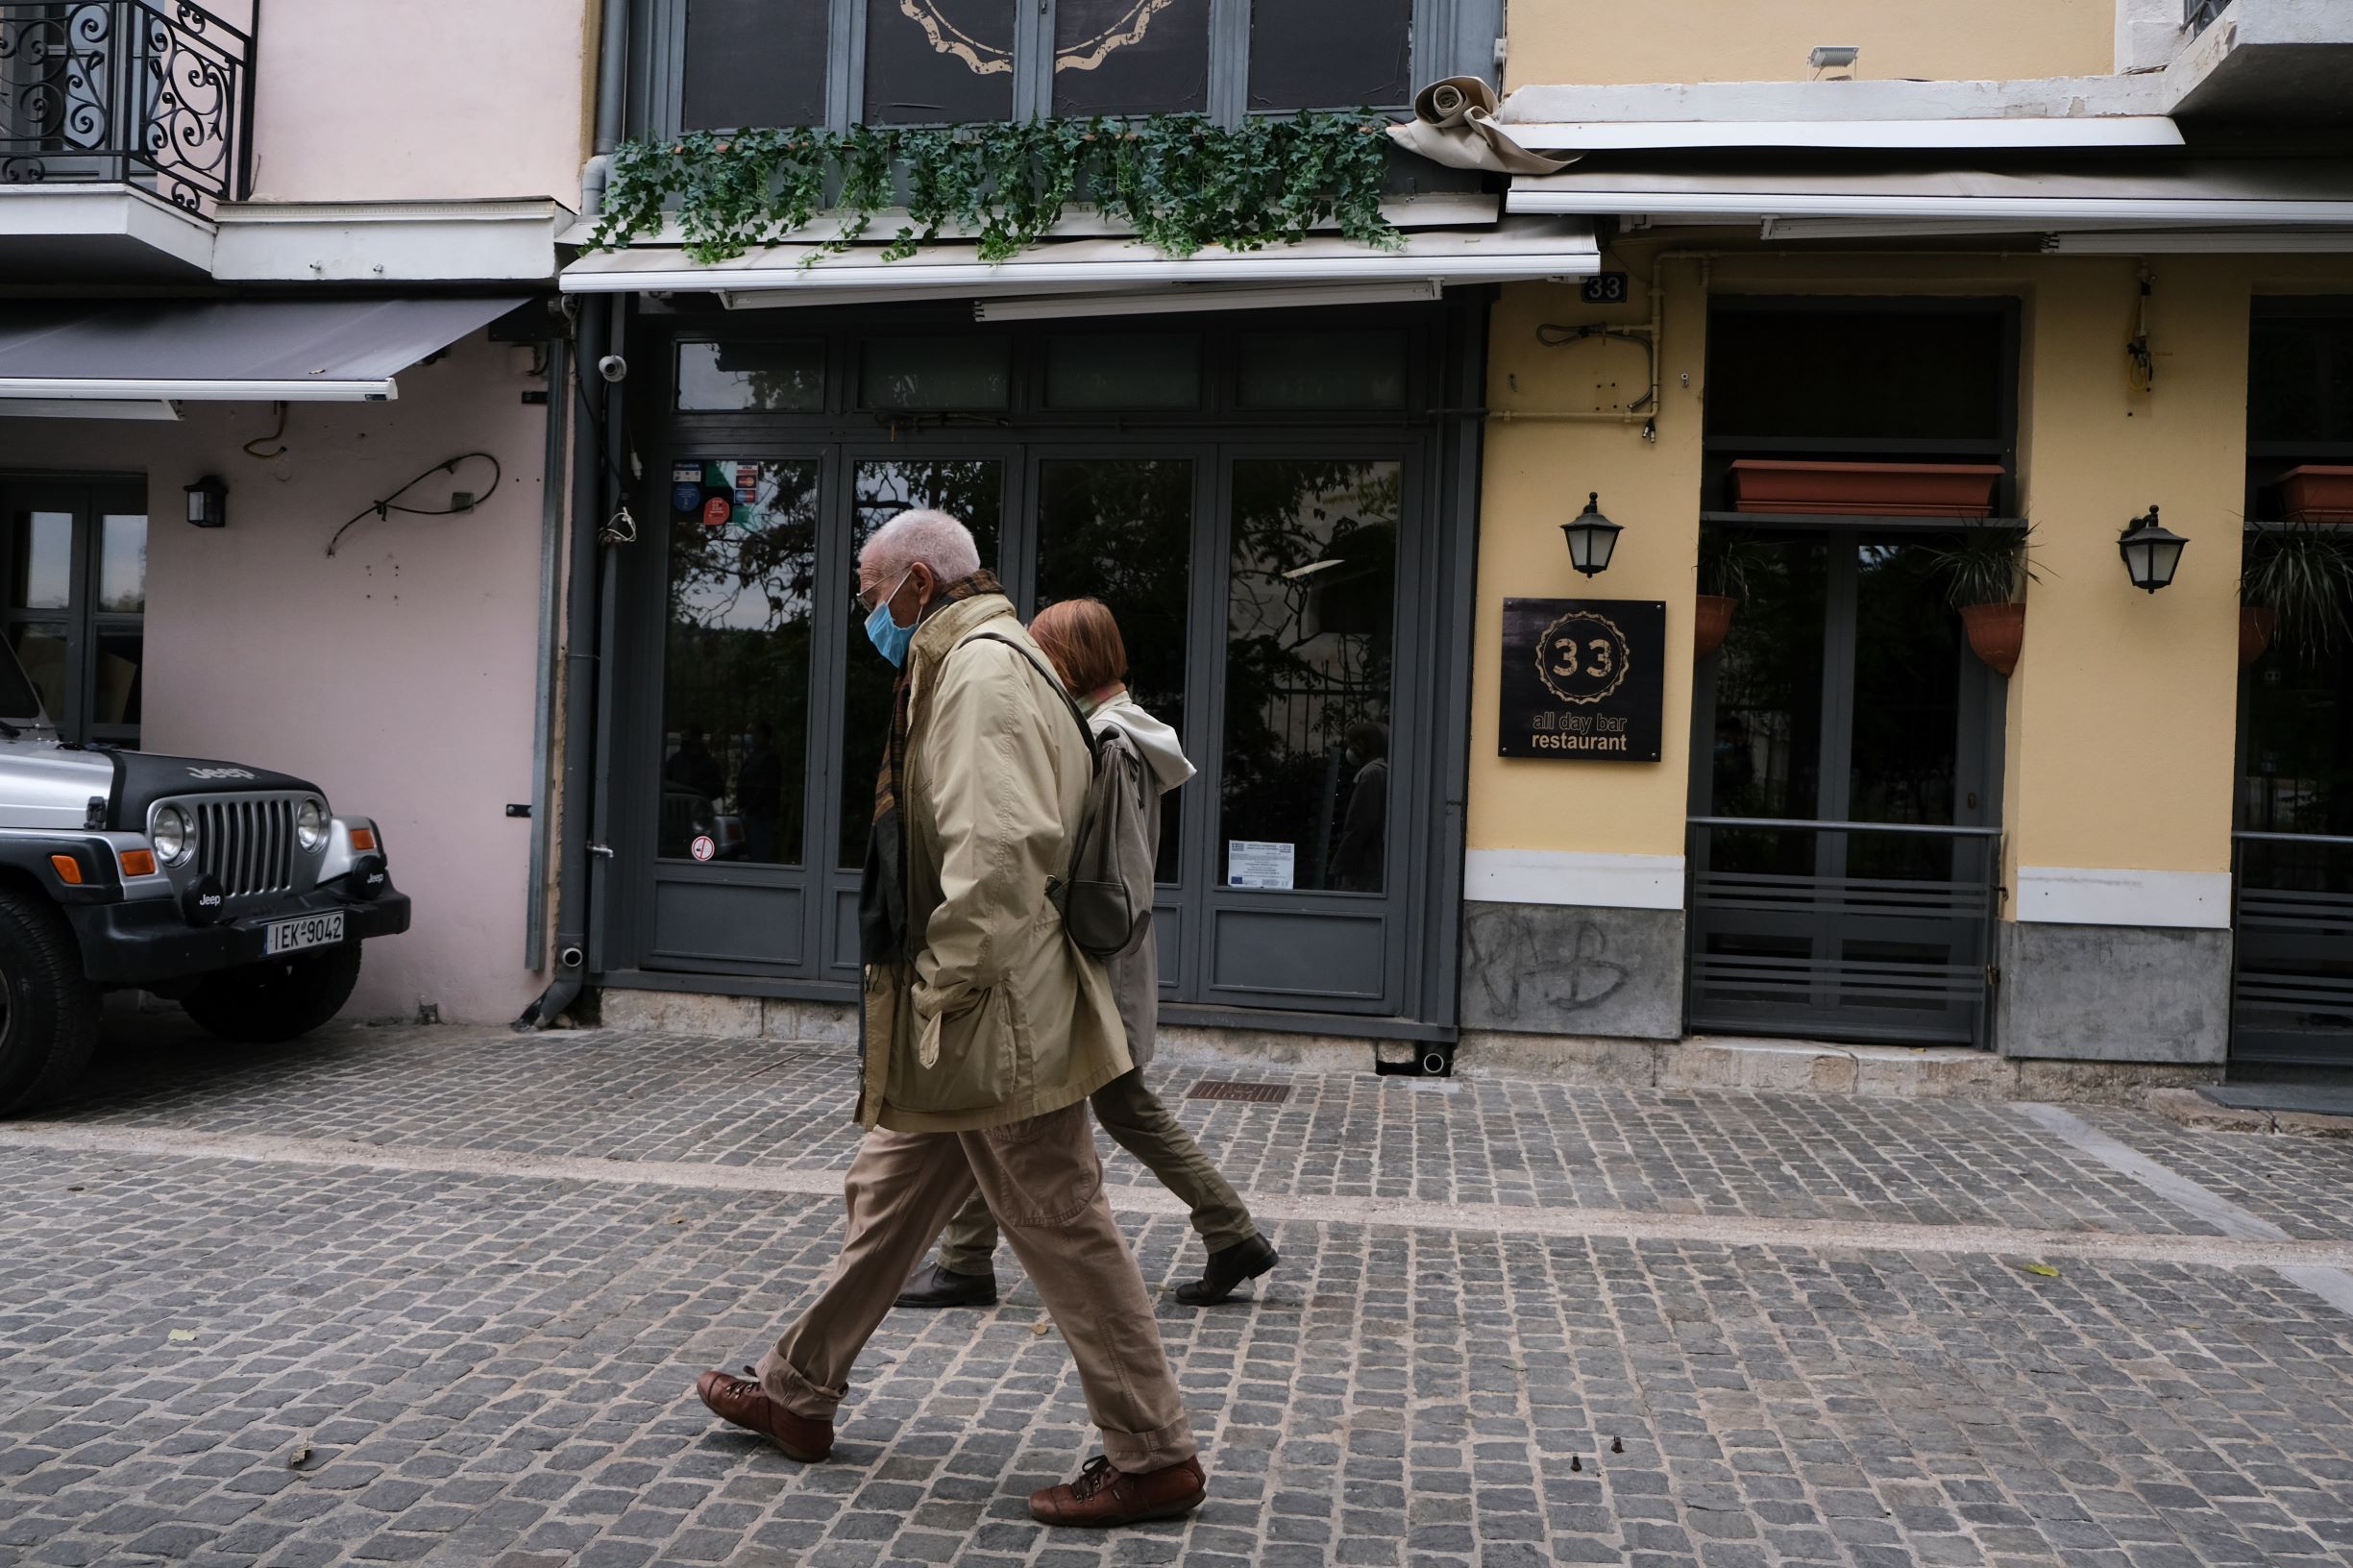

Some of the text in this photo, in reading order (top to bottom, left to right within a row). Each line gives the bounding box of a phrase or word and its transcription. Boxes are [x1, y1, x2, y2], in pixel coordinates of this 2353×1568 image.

[1589, 276, 1620, 298] 33
[1553, 638, 1612, 677] 33
[1532, 711, 1627, 735] all day bar
[1532, 732, 1628, 750] restaurant
[367, 872, 383, 884] Jeep
[199, 894, 221, 906] Jeep
